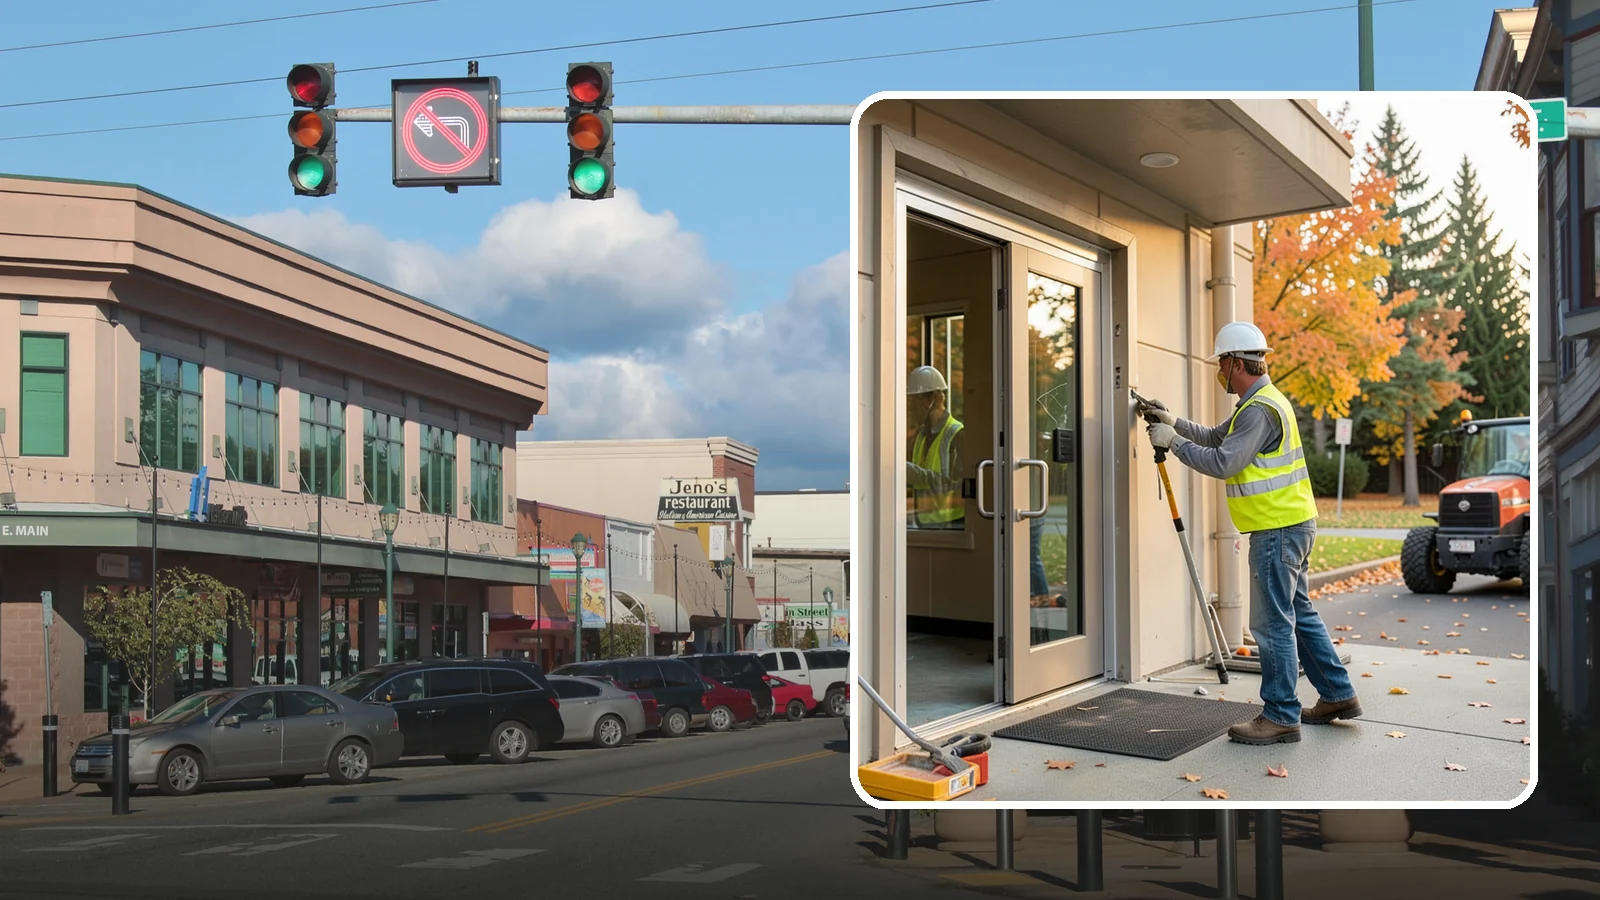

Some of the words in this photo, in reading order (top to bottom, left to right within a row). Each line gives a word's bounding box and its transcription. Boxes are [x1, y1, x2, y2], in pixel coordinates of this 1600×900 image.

[670, 480, 727, 494] Jeno's
[665, 496, 731, 509] restaurant
[659, 510, 681, 519] Italian
[686, 510, 714, 519] American
[715, 510, 737, 519] Cuisine
[2, 525, 13, 536] E.
[15, 525, 49, 536] MAIN
[797, 608, 828, 617] Street
[790, 619, 823, 627] lass
